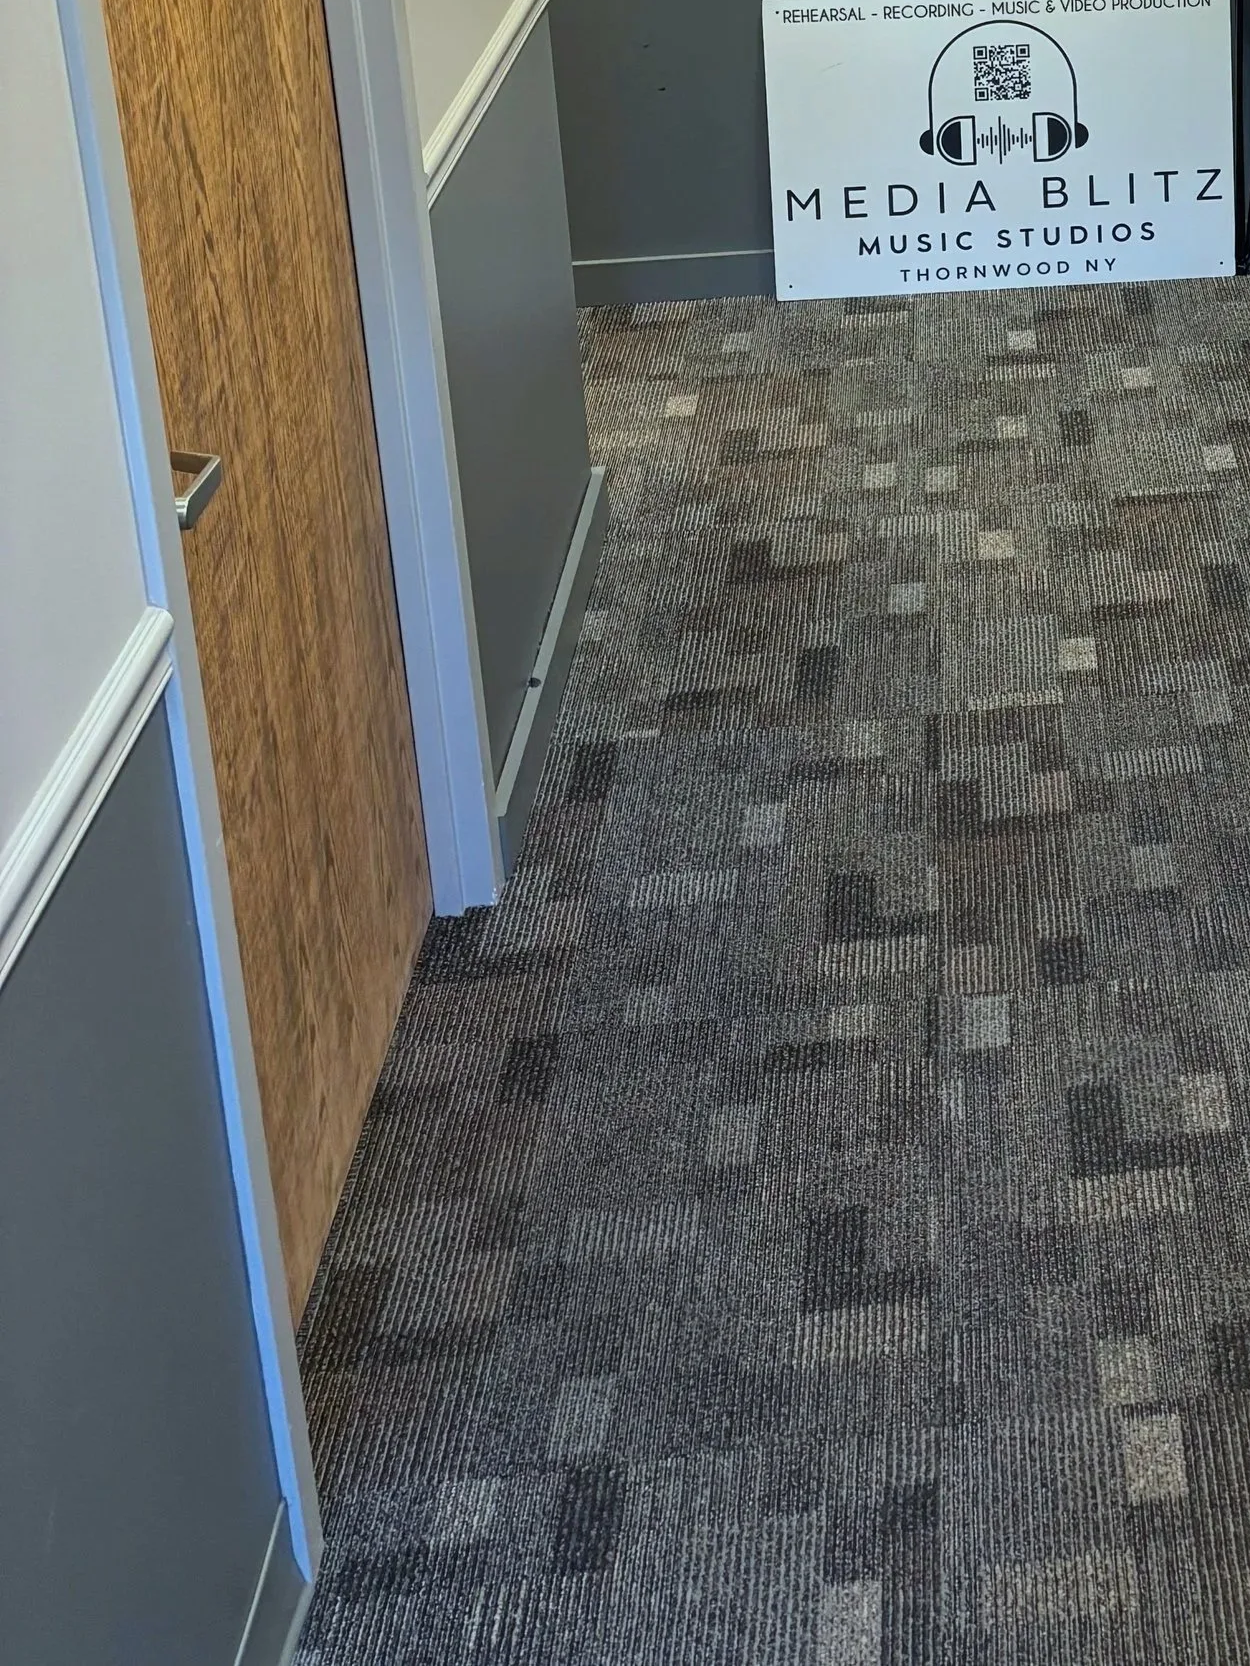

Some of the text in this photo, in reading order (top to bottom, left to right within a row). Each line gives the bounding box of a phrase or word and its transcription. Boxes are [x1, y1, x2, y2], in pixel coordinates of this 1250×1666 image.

[783, 7, 866, 23] REHEARSAL
[883, 3, 974, 19] RECORDING
[992, 0, 1040, 16] MUSIC
[1045, 0, 1056, 13] &
[786, 168, 1224, 222] MEDIA BLITZ
[858, 221, 1156, 256] MUSIC STUDIOS
[900, 257, 1118, 283] THORNWOOD NY
